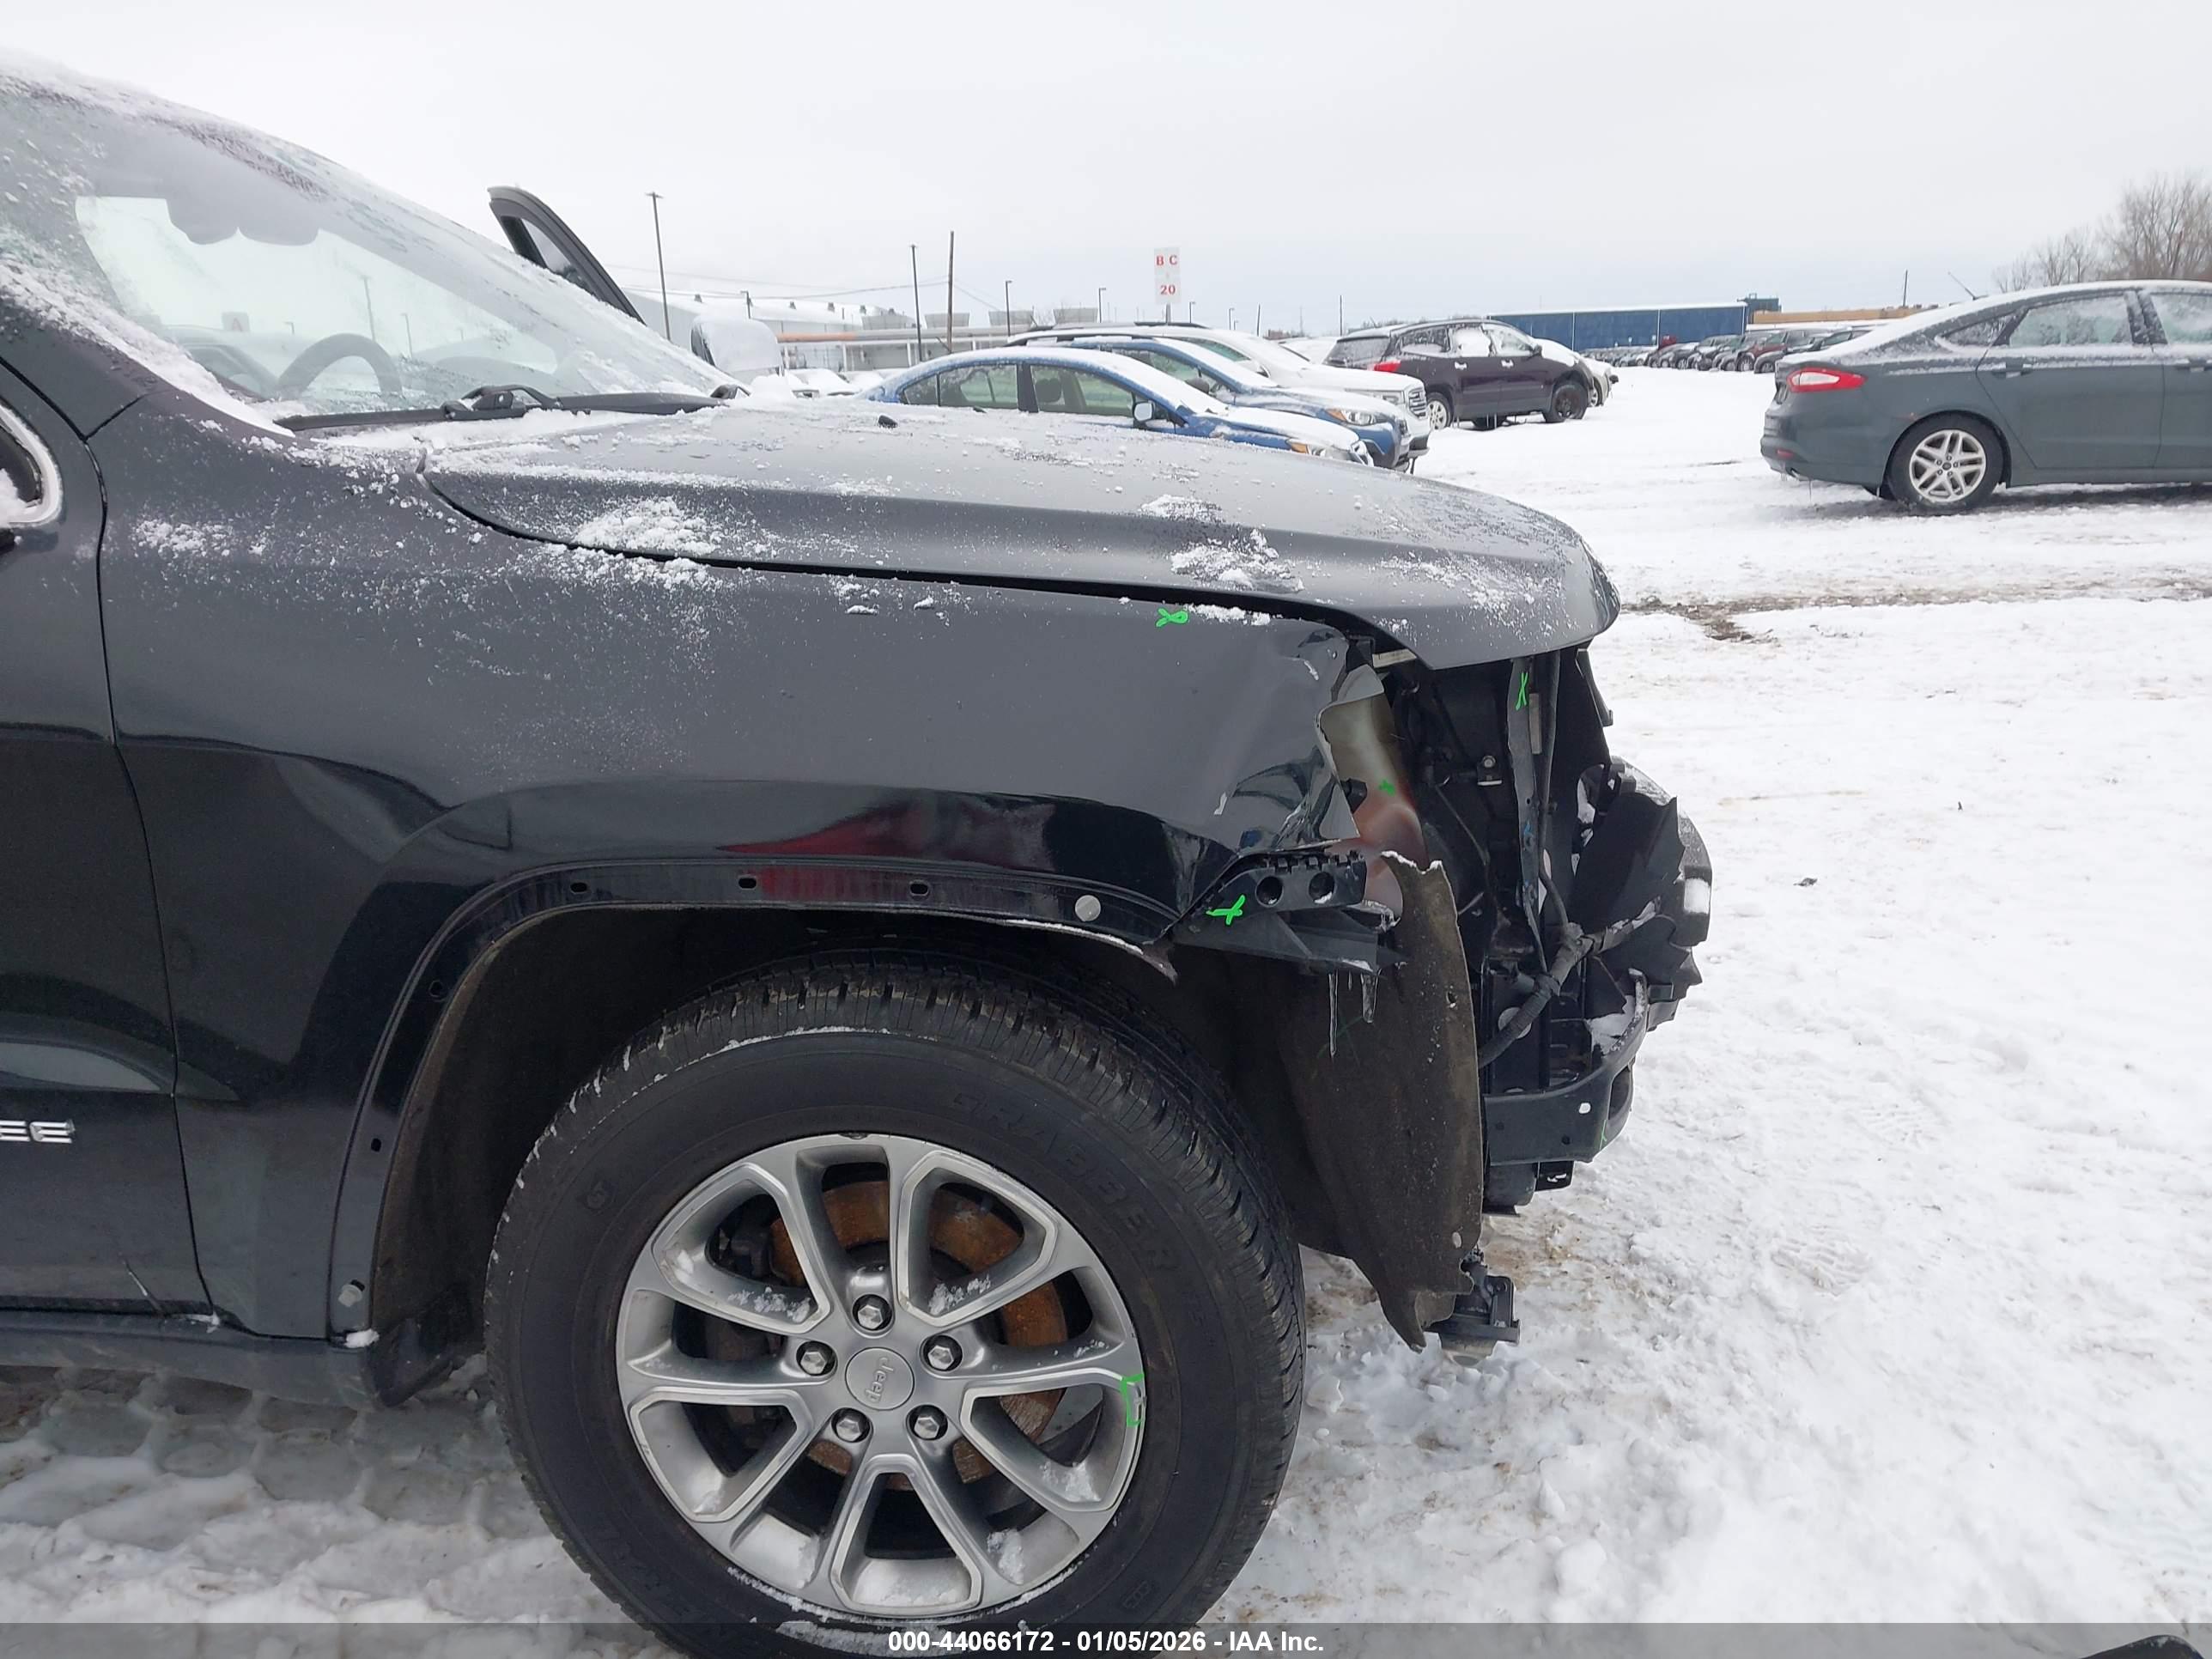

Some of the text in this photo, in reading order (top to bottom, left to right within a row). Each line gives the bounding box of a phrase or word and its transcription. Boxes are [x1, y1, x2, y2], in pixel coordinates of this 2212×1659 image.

[1156, 254, 1177, 266] B C
[1160, 283, 1176, 295] 20
[865, 1357, 894, 1403] Jeep
